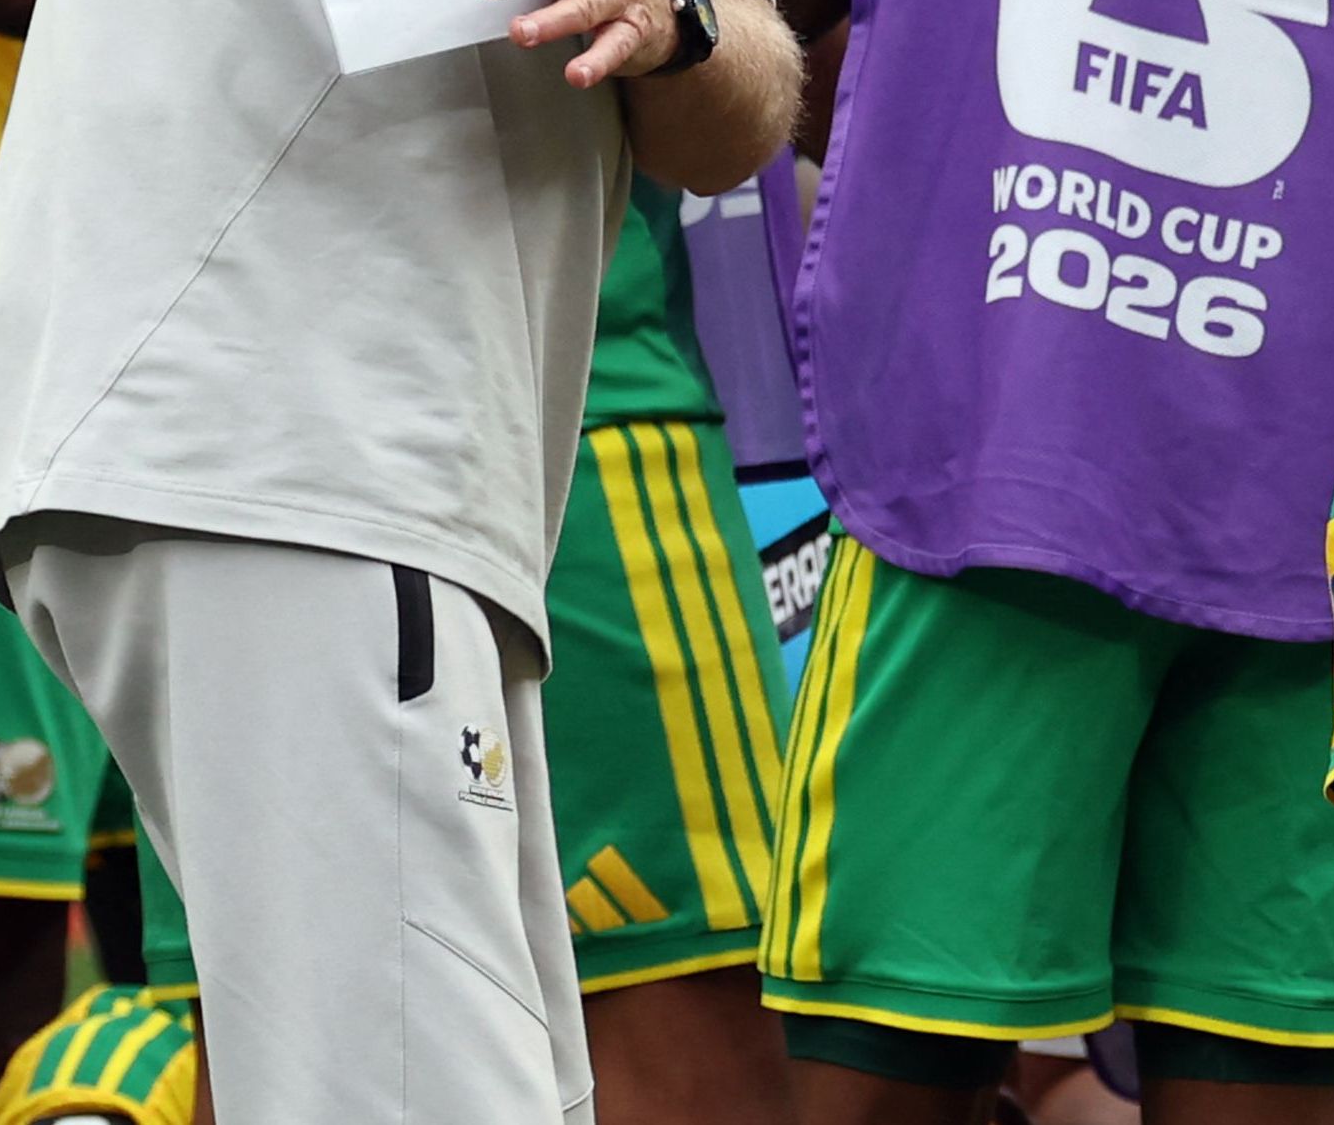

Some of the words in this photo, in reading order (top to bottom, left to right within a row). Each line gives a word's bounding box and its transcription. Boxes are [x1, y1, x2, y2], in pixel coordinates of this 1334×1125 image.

[1072, 41, 1209, 130] FIFA
[993, 163, 1152, 239] WORLD
[1161, 206, 1283, 270] CUP
[985, 223, 1268, 358] 2026
